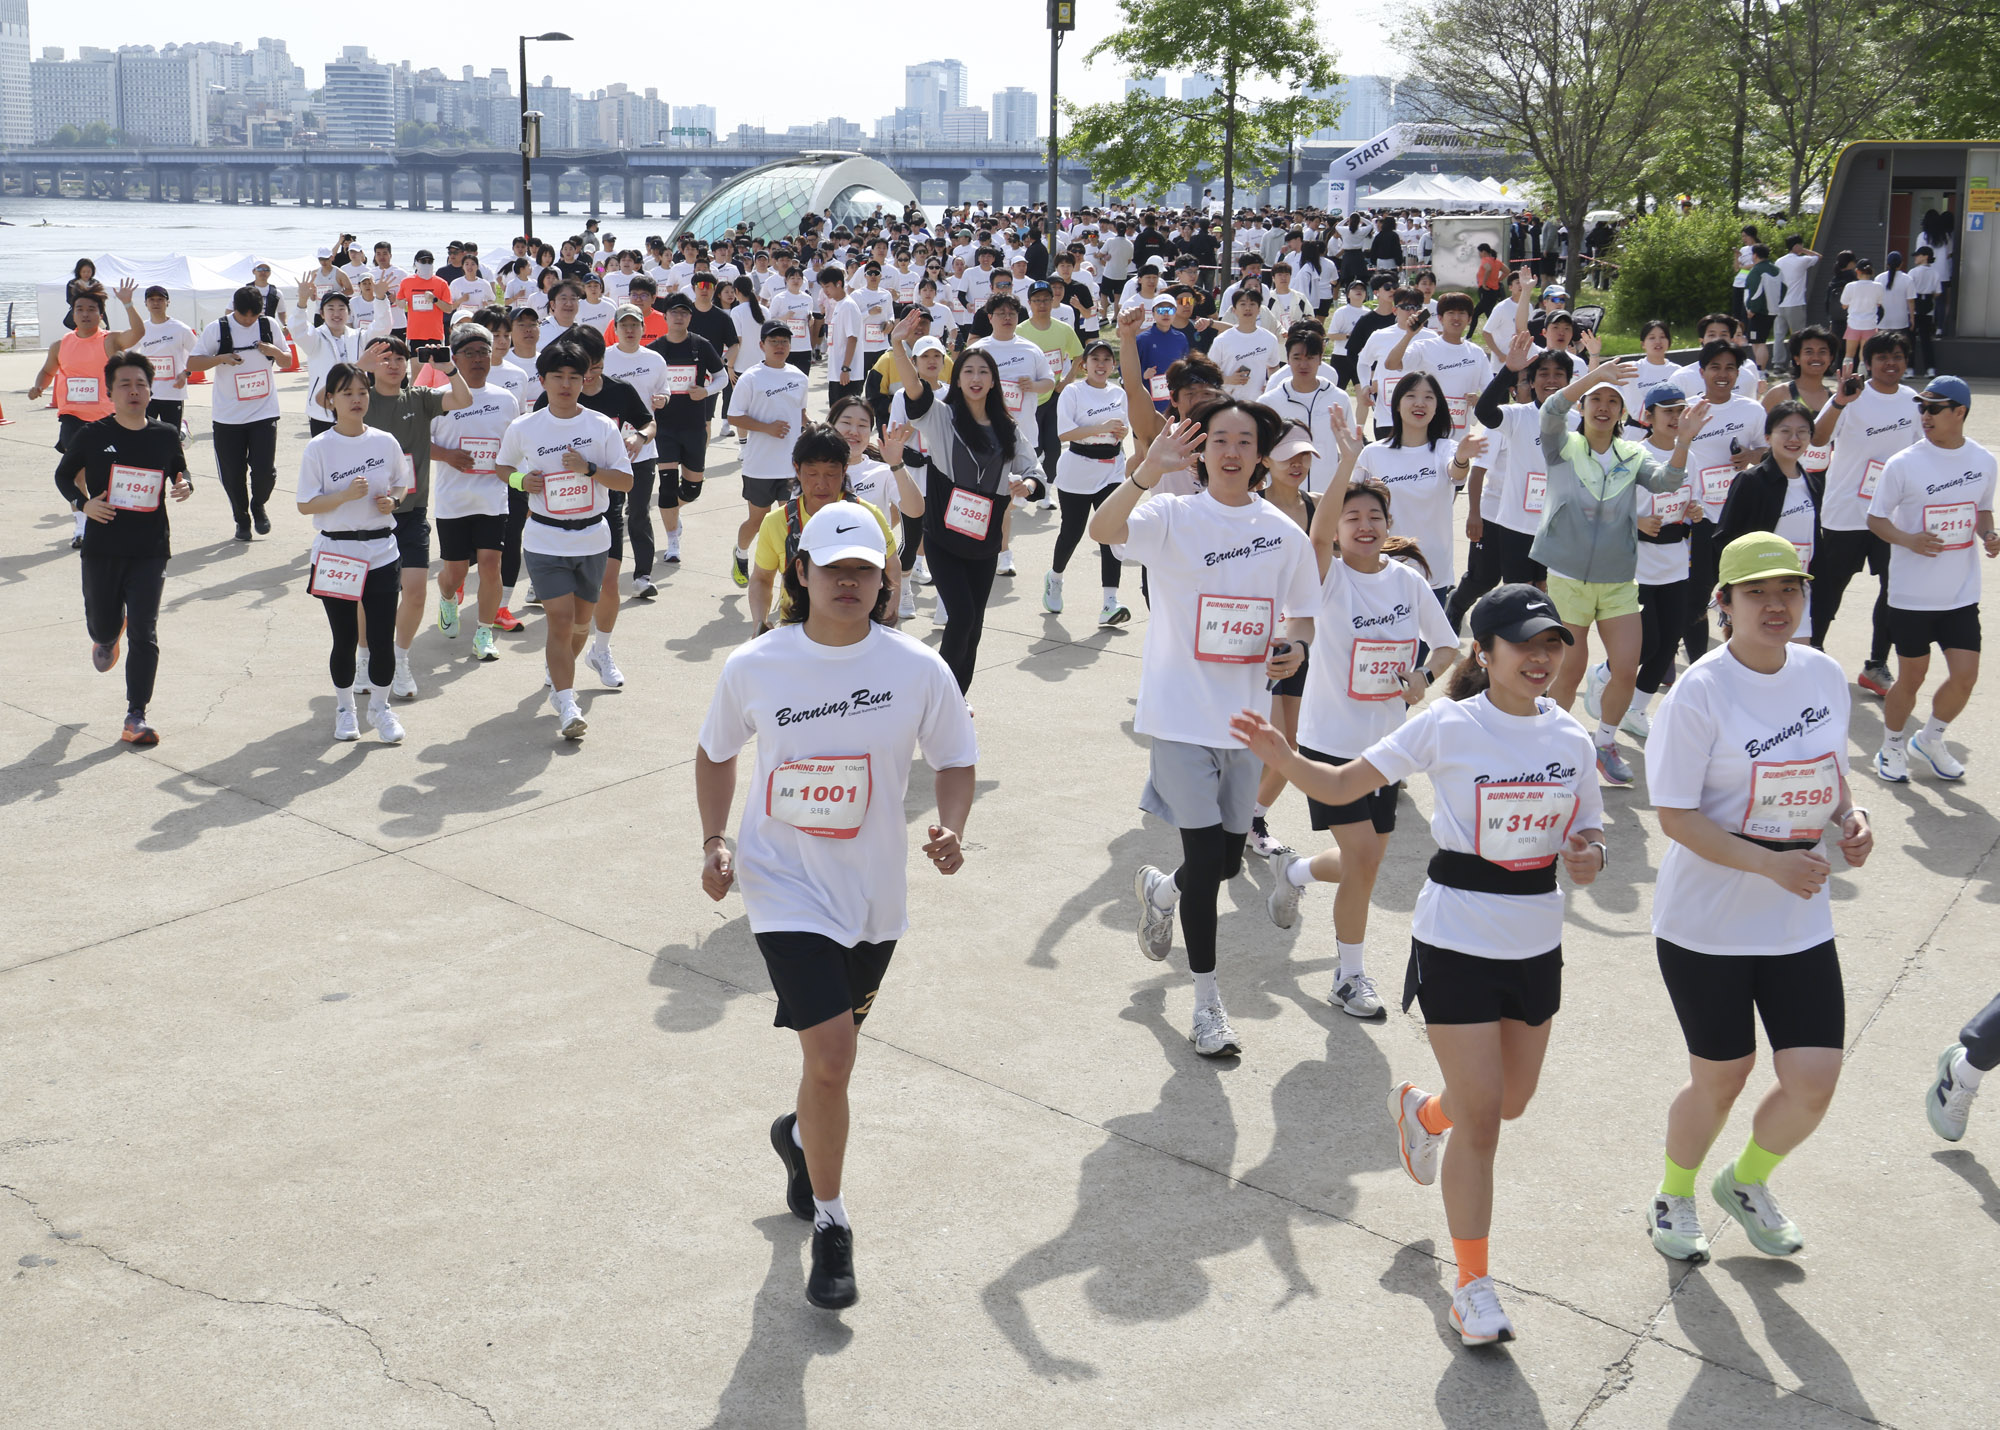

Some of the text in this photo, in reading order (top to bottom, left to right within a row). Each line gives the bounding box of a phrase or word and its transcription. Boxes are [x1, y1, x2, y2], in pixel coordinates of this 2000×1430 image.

[1345, 137, 1391, 171] START
[1235, 346, 1267, 361] Burning Run
[1011, 356, 1025, 365] Run
[1438, 358, 1476, 371] Burning Run
[246, 380, 266, 388] 1724
[766, 386, 788, 398] Burning
[454, 404, 500, 420] Burning Run
[1086, 406, 1112, 417] Burning
[1725, 422, 1744, 432] Run
[1866, 418, 1912, 436] Burning Run
[572, 437, 592, 446] Run
[472, 451, 496, 460] 1378
[1804, 450, 1826, 460] 1065
[330, 458, 384, 482] Burning Run
[126, 482, 155, 494] 1941
[854, 482, 876, 493] Run
[1926, 470, 1983, 495] Burning Run
[559, 484, 588, 497] 2289
[961, 508, 988, 522] 3382
[1781, 504, 1804, 517] urning
[1940, 518, 1972, 531] 2114
[1251, 536, 1283, 552] Run
[320, 568, 358, 582] W 3471
[1206, 601, 1235, 610] BURNING
[1206, 620, 1264, 636] M 1463
[1360, 664, 1368, 672] W
[775, 688, 894, 727] Burning Run
[1744, 706, 1830, 758] Burning Run
[816, 764, 835, 772] RUN
[1546, 762, 1576, 782] Run
[1762, 769, 1798, 778] BURNING
[1798, 768, 1816, 776] RUN
[780, 786, 857, 803] M 1001
[1487, 792, 1526, 800] BURNING
[1761, 786, 1832, 806] W 3598
[1488, 814, 1561, 832] W 3141
[1751, 824, 1781, 833] E-124
